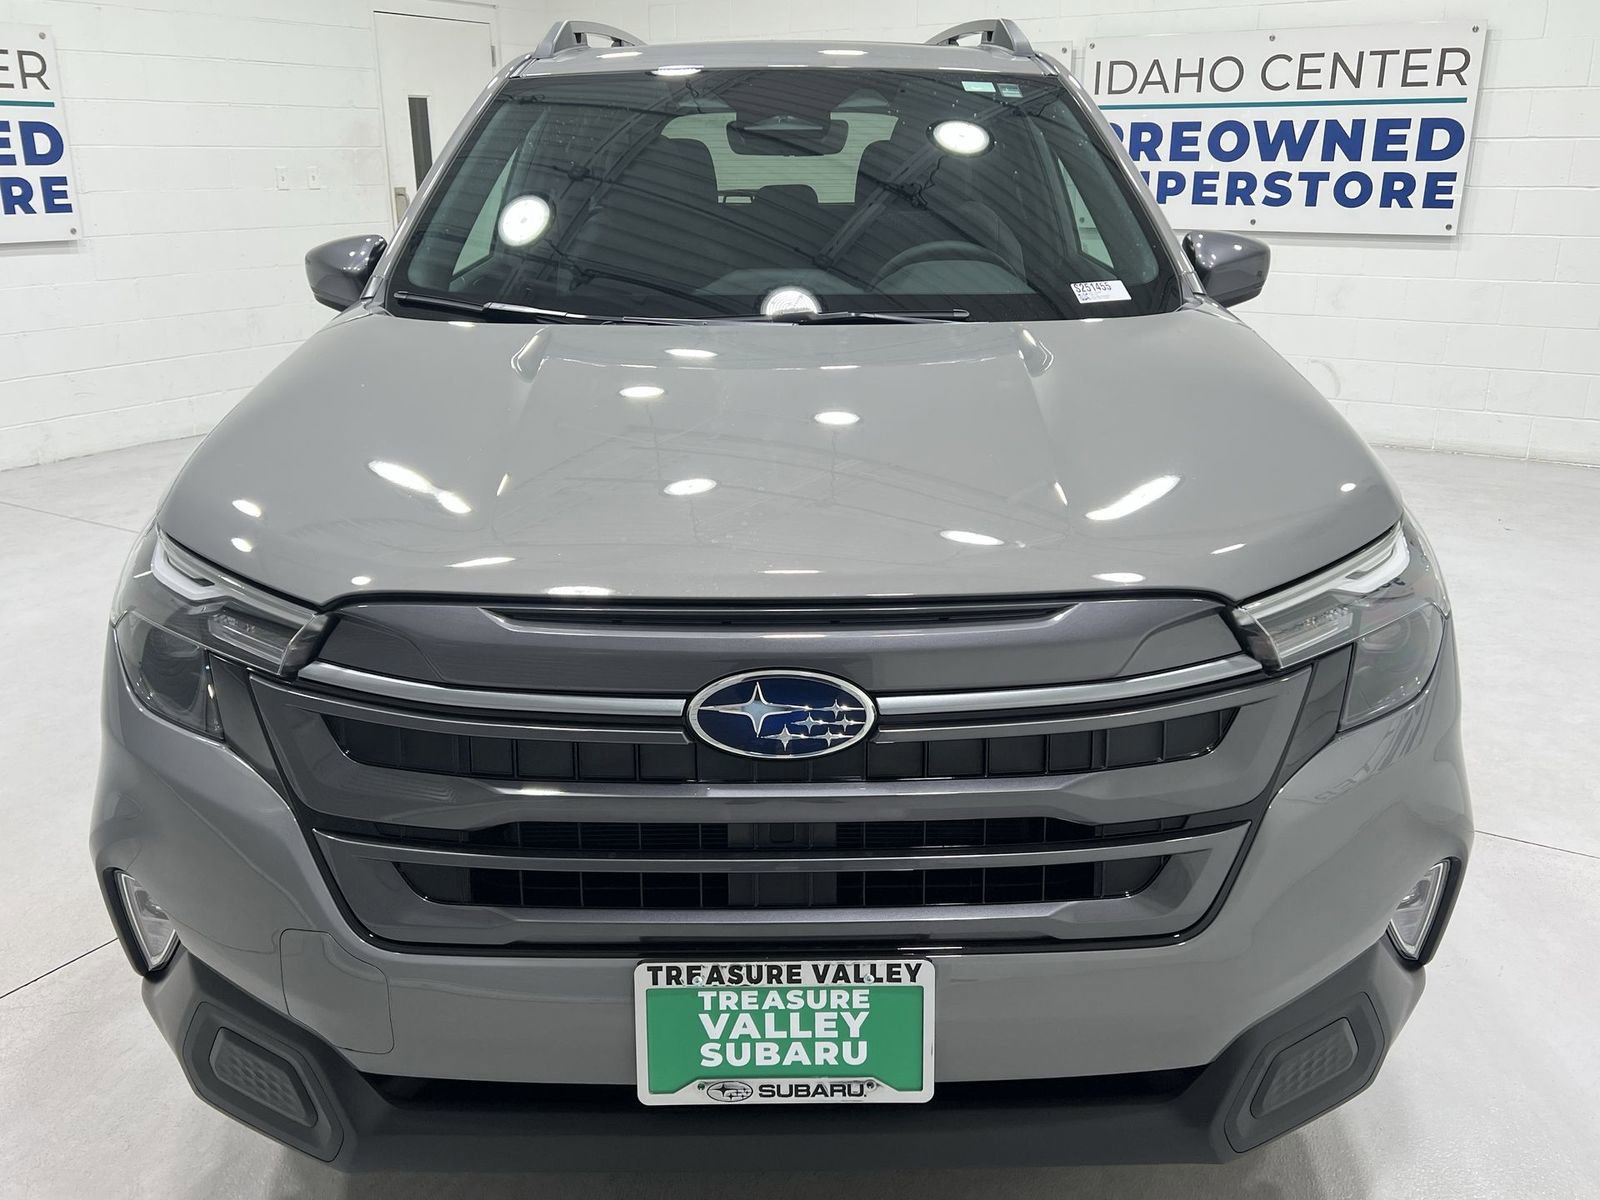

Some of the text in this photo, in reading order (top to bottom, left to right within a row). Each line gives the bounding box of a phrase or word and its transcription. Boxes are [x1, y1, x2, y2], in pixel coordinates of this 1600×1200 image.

[1094, 46, 1471, 95] IDAHO CENTER
[1109, 117, 1466, 162] REOWNED
[1140, 170, 1458, 209] PERSTORE
[646, 963, 923, 986] TREASURE VALLEY
[698, 989, 870, 1011] TREASURE
[698, 1011, 870, 1040] VALLEY
[700, 1041, 868, 1068] SUBARU
